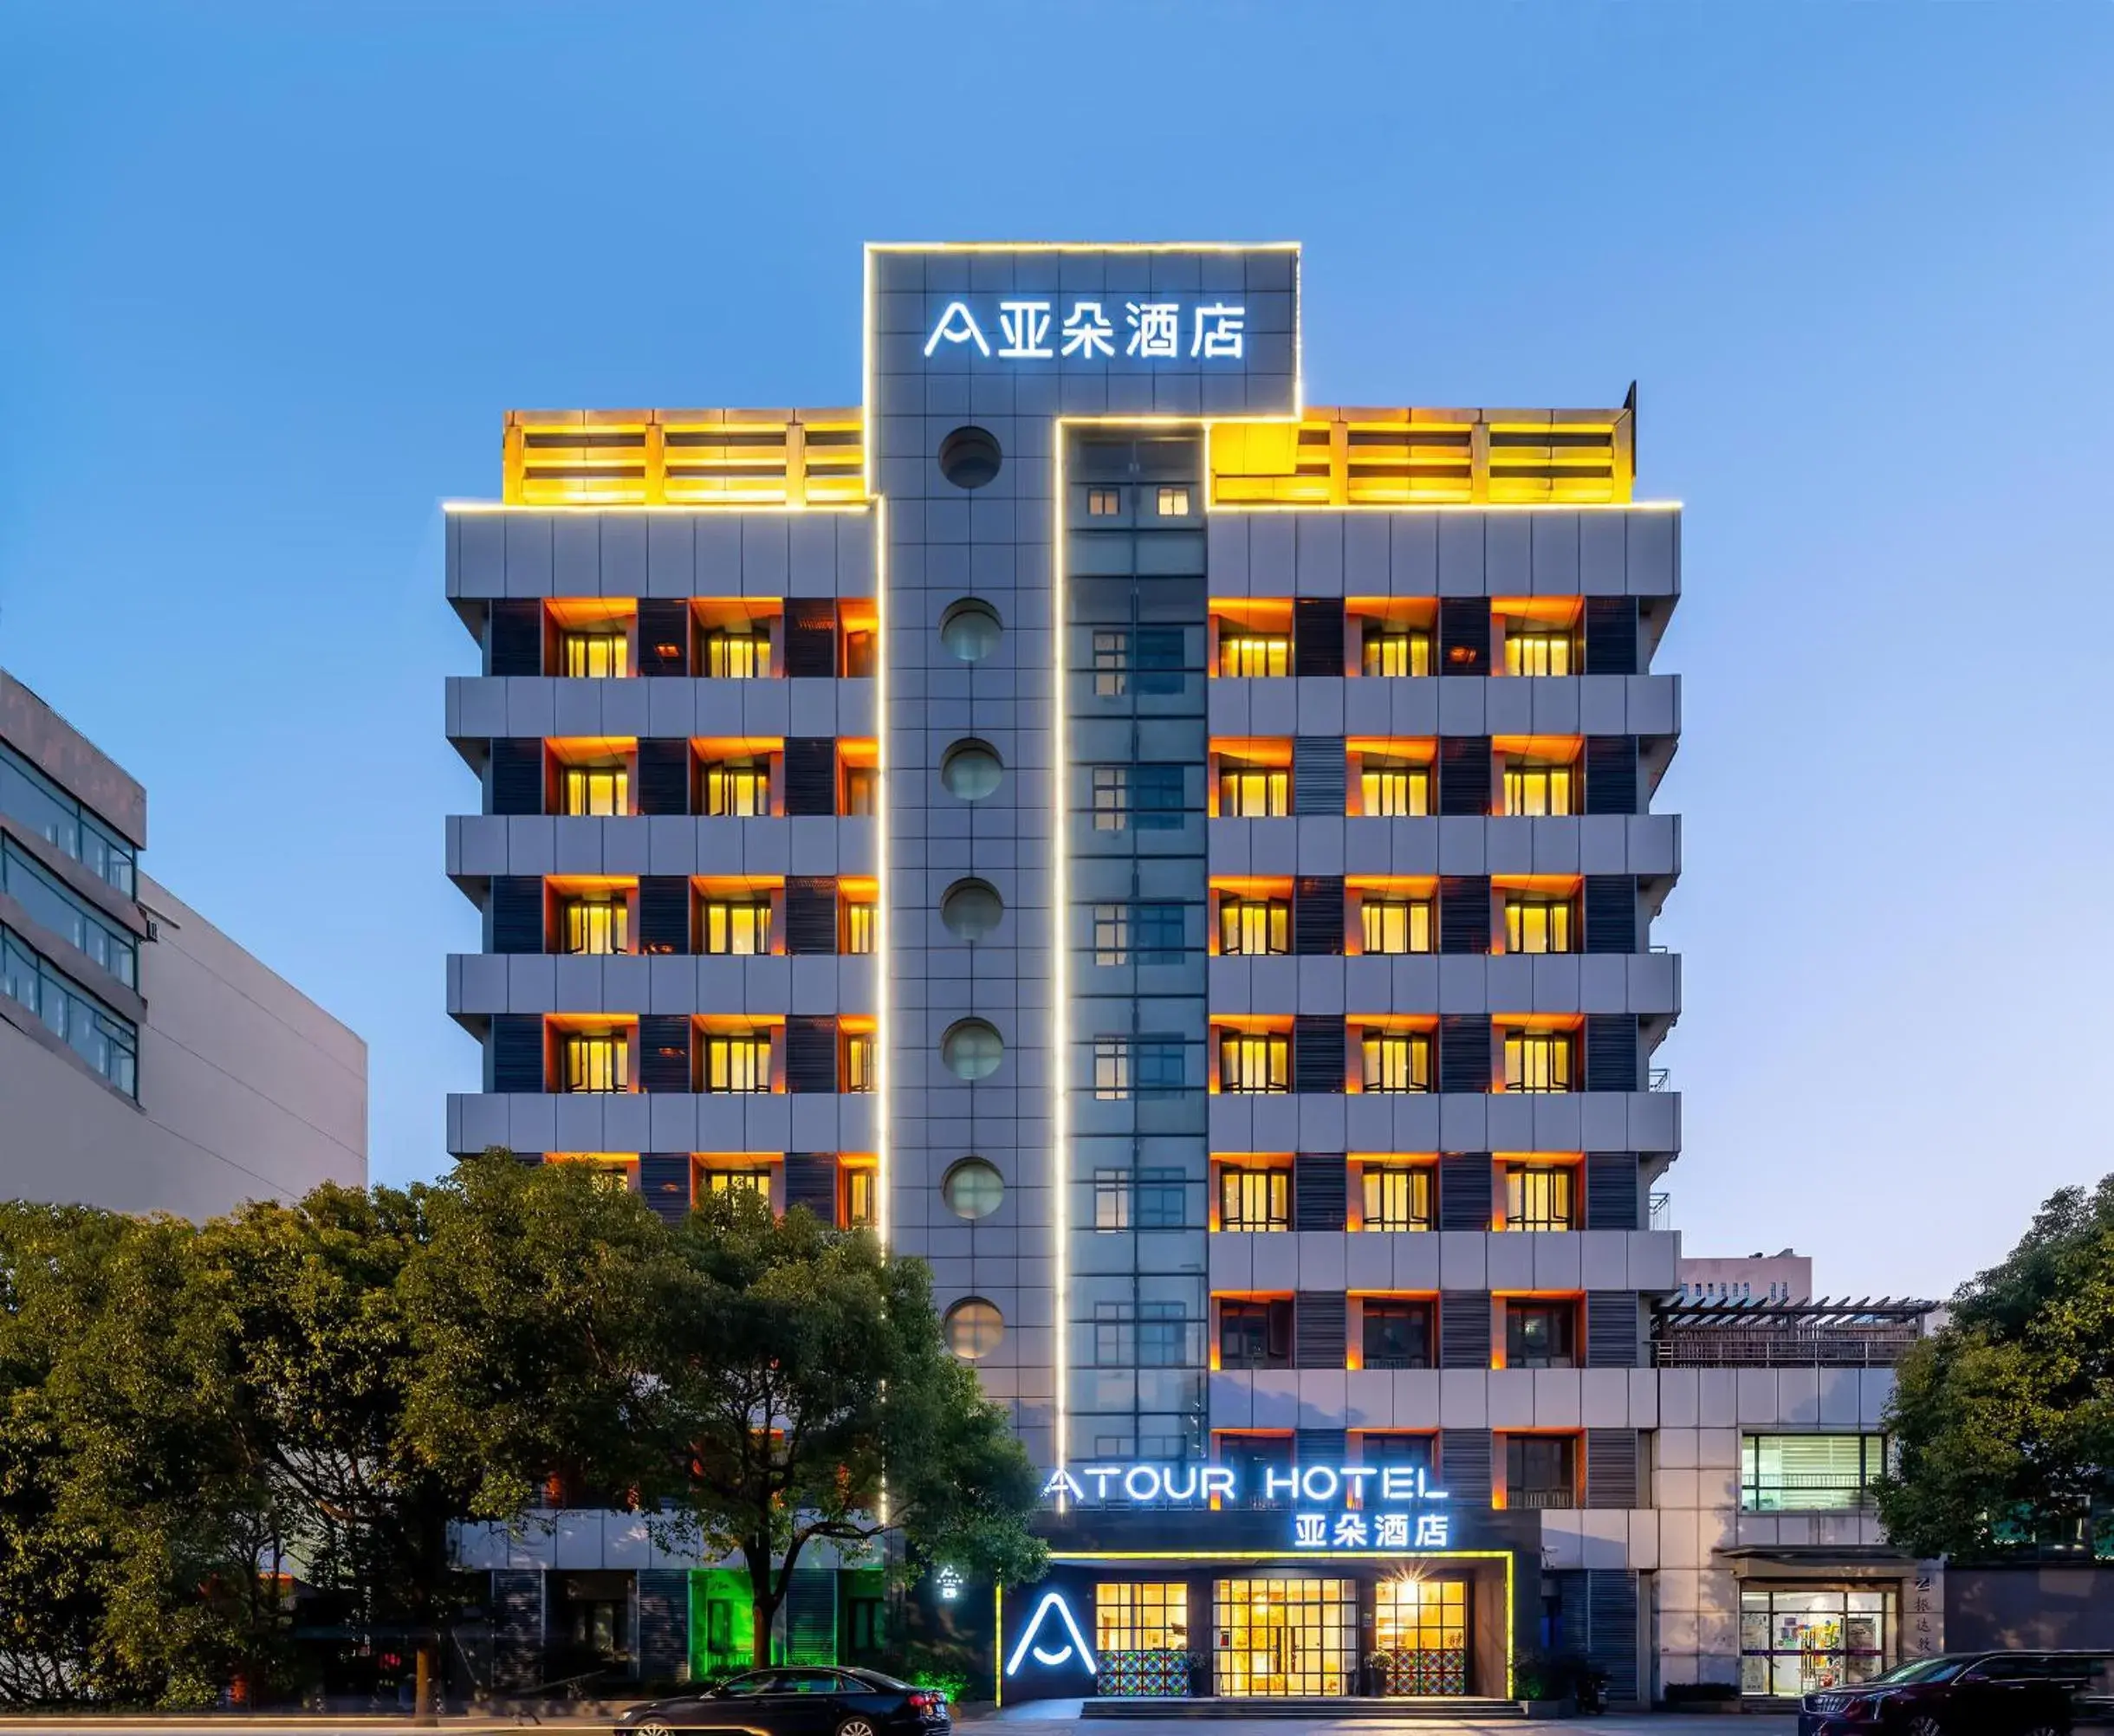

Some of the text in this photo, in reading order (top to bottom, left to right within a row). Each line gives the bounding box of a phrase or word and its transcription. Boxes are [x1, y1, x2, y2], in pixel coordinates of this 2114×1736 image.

[1041, 1466, 1449, 1500] ATOUR HOTEL
[1294, 1513, 1449, 1547] 亚朵酒店
